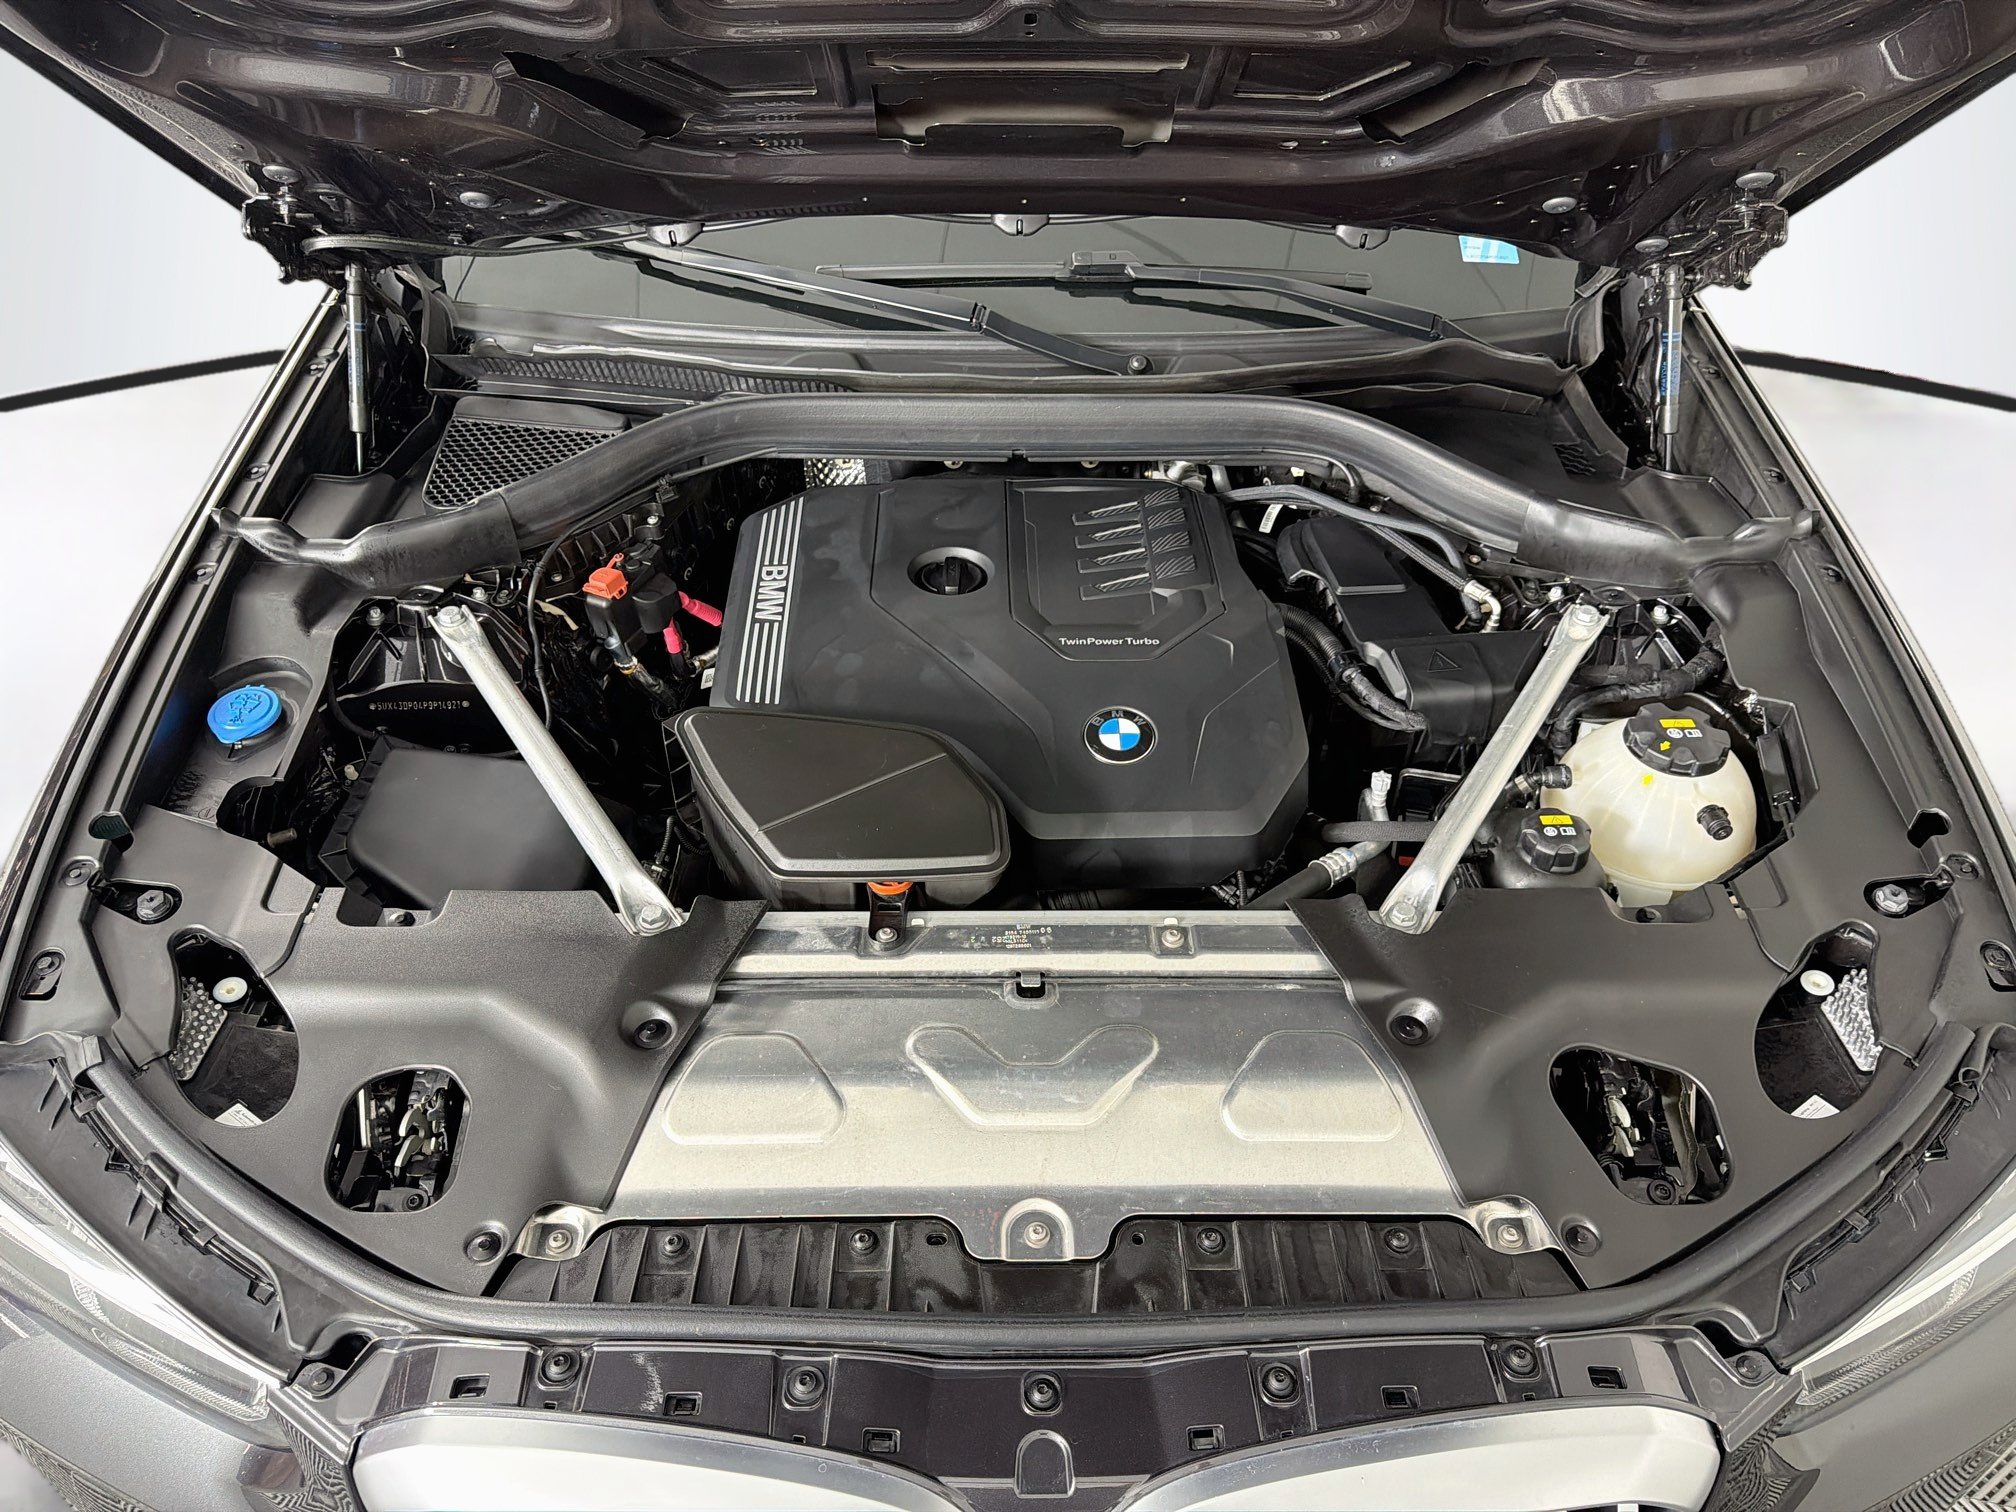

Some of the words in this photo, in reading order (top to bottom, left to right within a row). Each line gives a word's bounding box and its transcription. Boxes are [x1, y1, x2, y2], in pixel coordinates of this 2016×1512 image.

[755, 565, 789, 621] BMW
[1058, 637, 1124, 646] TwinPower
[1124, 637, 1160, 646] Turbo
[1090, 710, 1147, 726] BMW
